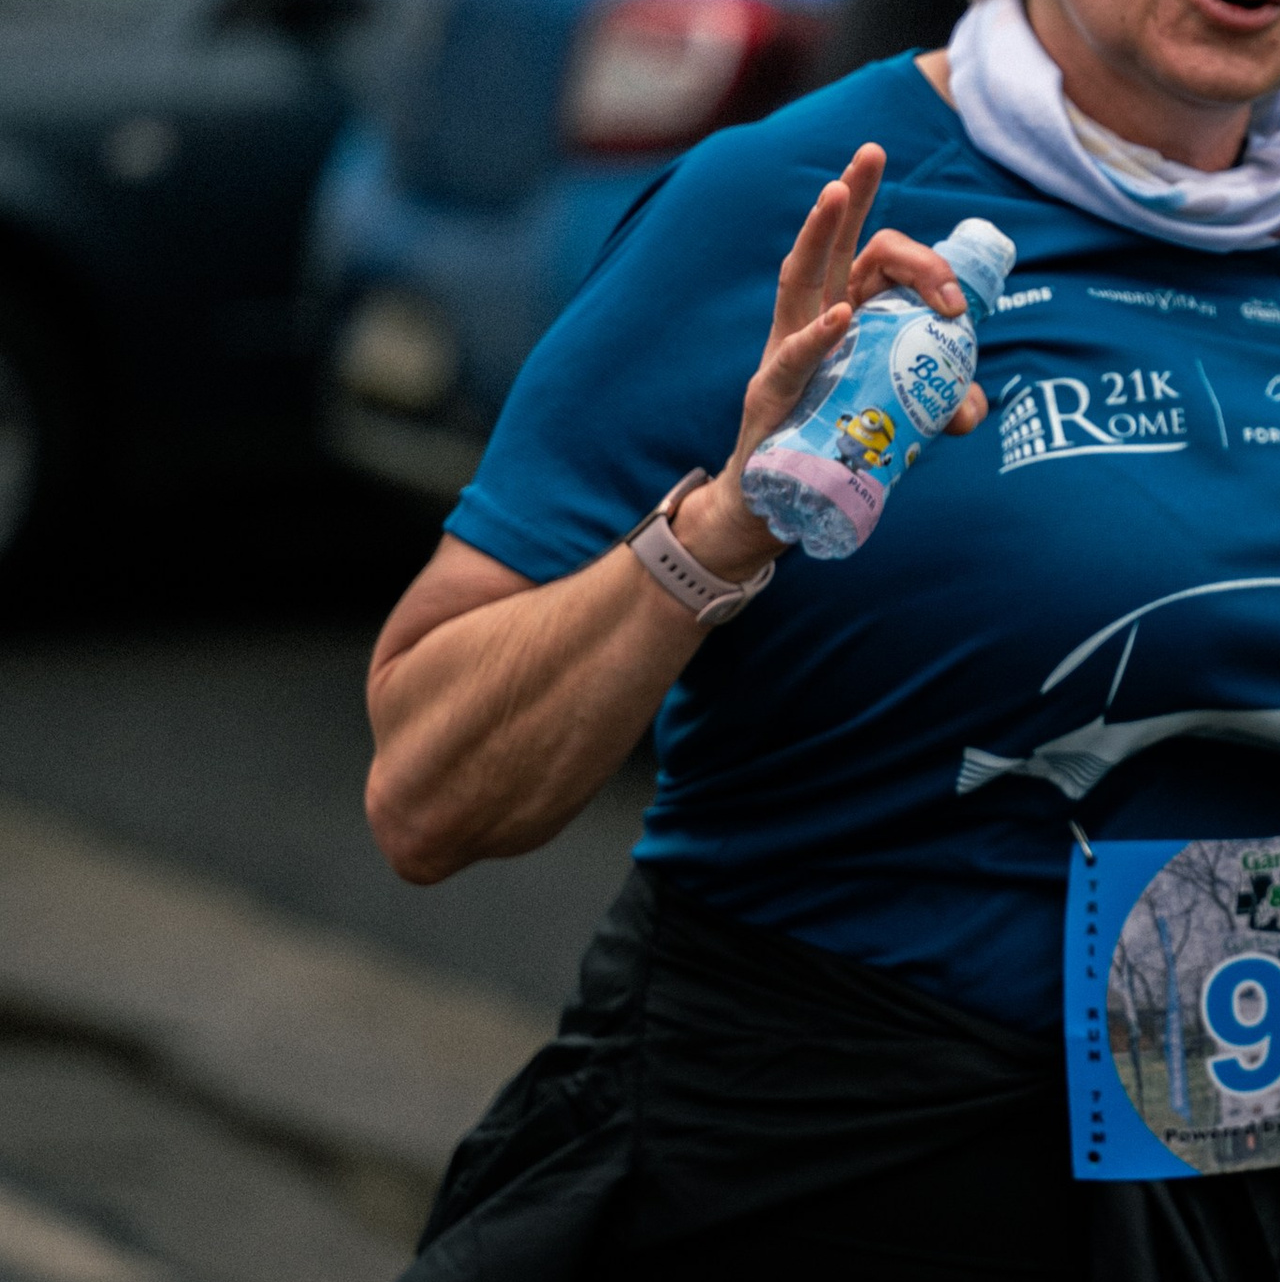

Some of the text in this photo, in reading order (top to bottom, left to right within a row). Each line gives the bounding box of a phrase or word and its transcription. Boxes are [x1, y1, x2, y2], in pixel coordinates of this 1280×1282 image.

[908, 353, 961, 414] Baby
[908, 381, 941, 422] Bottle
[1101, 369, 1181, 406] 21K
[1036, 377, 1187, 448] ROME
[1165, 1121, 1257, 1143] Powered
